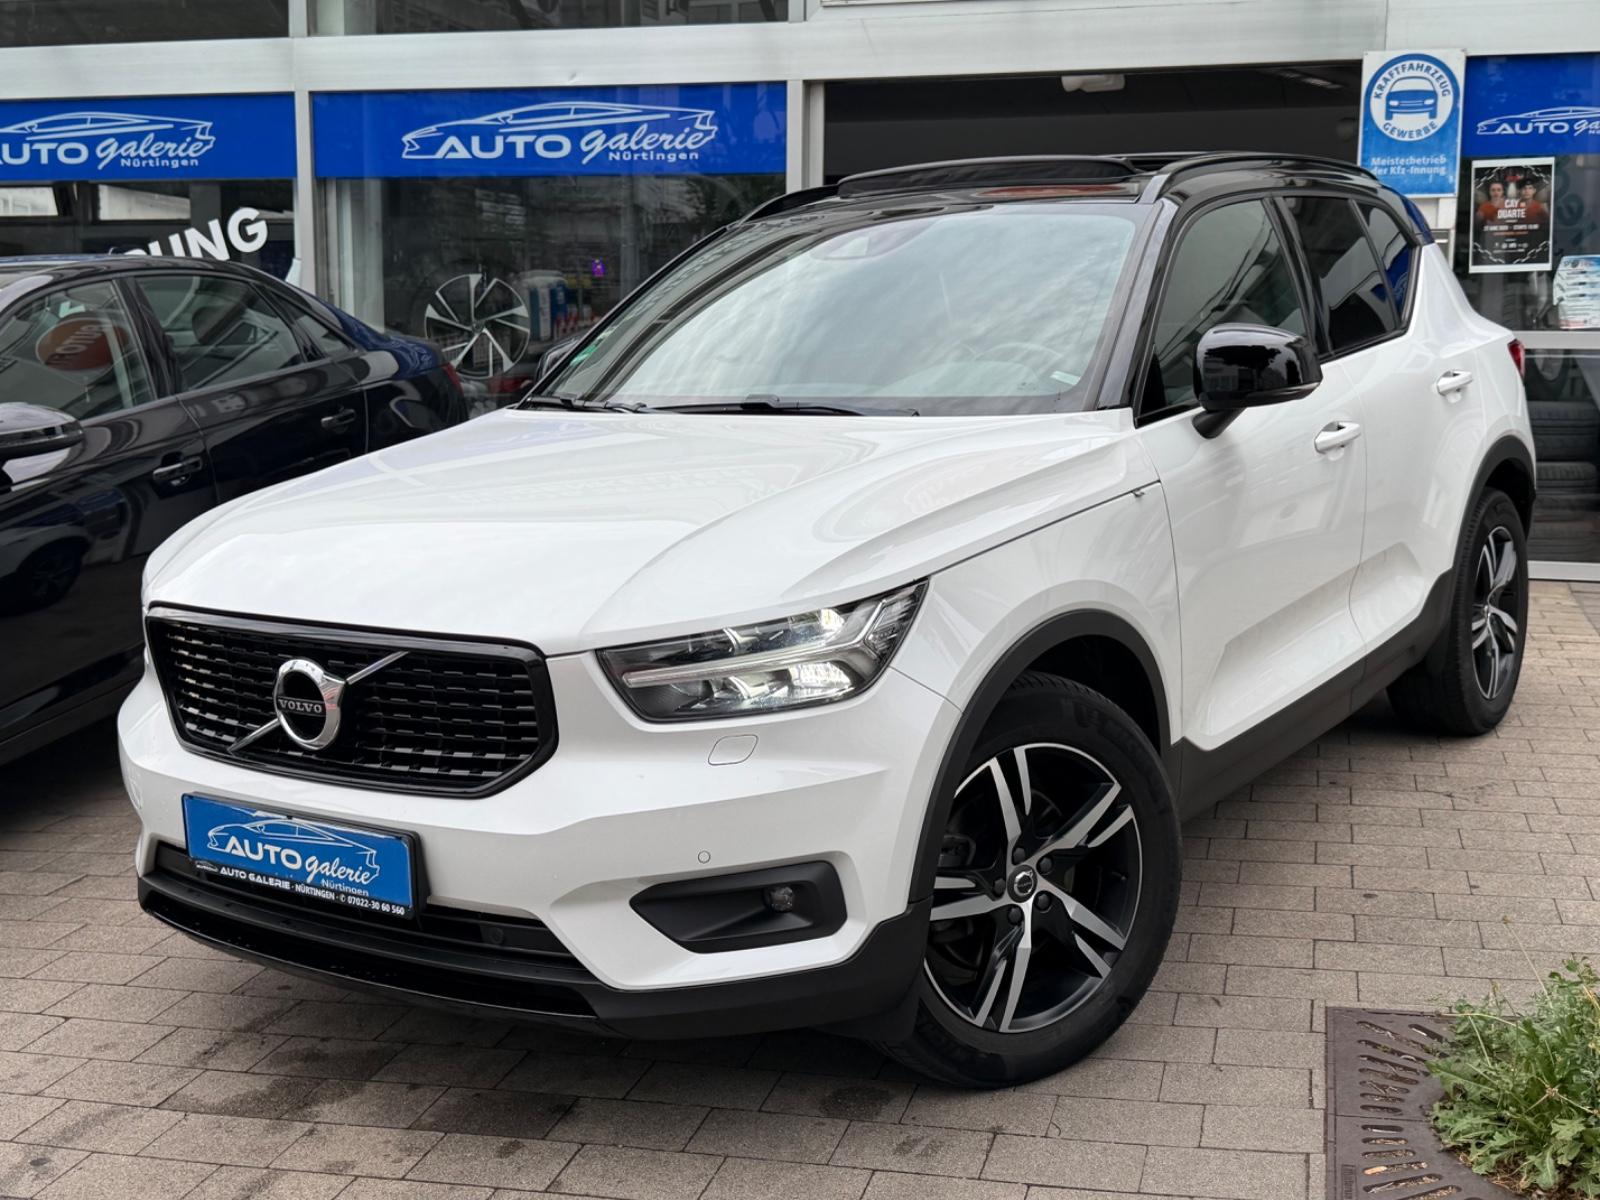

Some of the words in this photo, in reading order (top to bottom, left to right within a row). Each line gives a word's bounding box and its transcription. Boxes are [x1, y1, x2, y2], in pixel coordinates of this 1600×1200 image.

[1374, 63, 1451, 99] KRAFTFAHRZEUG
[1383, 121, 1438, 138] GEWERBE
[1496, 121, 1570, 135] AUTO
[0, 142, 88, 165] UTO
[96, 133, 205, 170] galerie
[438, 134, 572, 159] AUTO
[580, 122, 702, 165] galerie
[120, 157, 199, 169] Nürtingen
[608, 150, 699, 162] Nürtingen
[1371, 154, 1447, 166] Meisterbetrieb
[1389, 165, 1447, 177] Kfz-Innung
[279, 700, 323, 714] VOLVO
[224, 836, 302, 871] AUTO
[305, 855, 375, 885] galerie
[219, 866, 247, 880] AUTO
[248, 872, 291, 891] GALERIE
[295, 883, 336, 901] NÜRTINGEN
[347, 895, 380, 911] 07022-30
[381, 902, 391, 914] 60
[321, 878, 369, 897] Nürtingen
